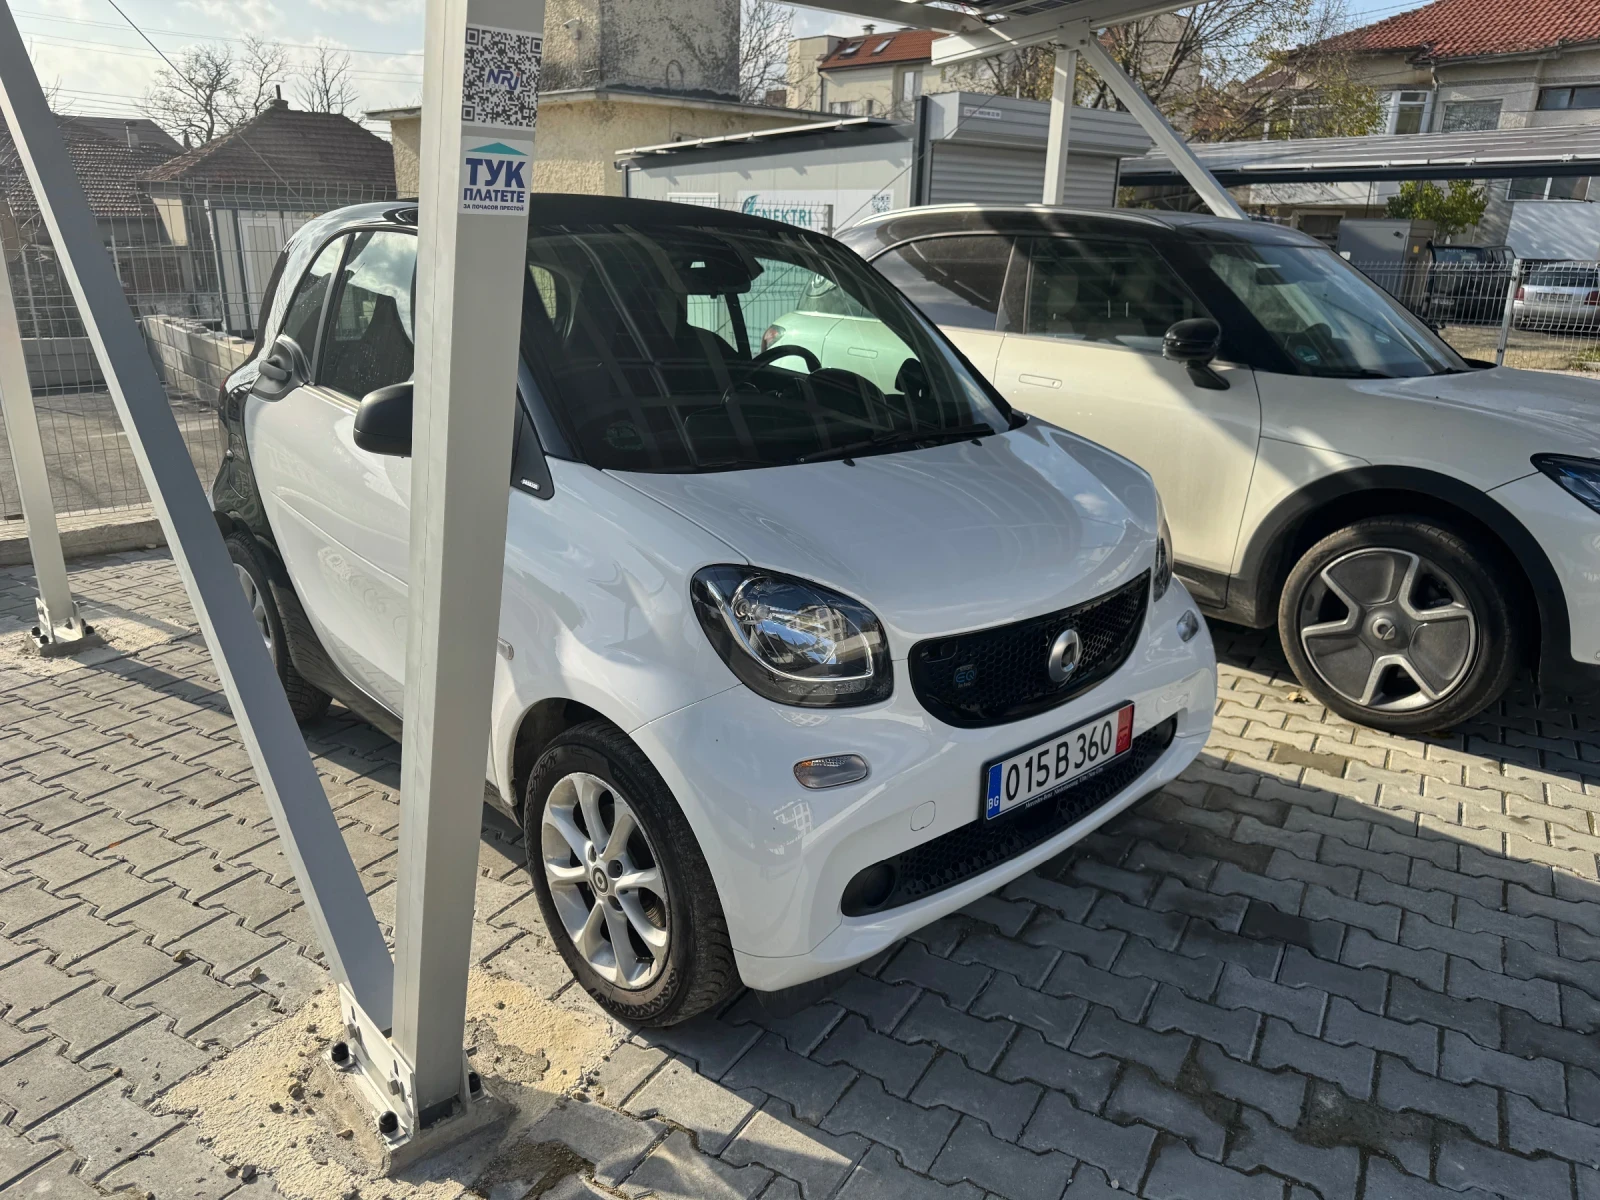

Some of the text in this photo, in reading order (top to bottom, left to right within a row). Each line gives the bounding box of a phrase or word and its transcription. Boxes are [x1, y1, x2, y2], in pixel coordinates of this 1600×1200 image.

[465, 157, 526, 188] ТУК
[463, 187, 526, 203] ПЛАТЕТЕ
[955, 670, 975, 683] EQ
[988, 795, 1000, 811] BG
